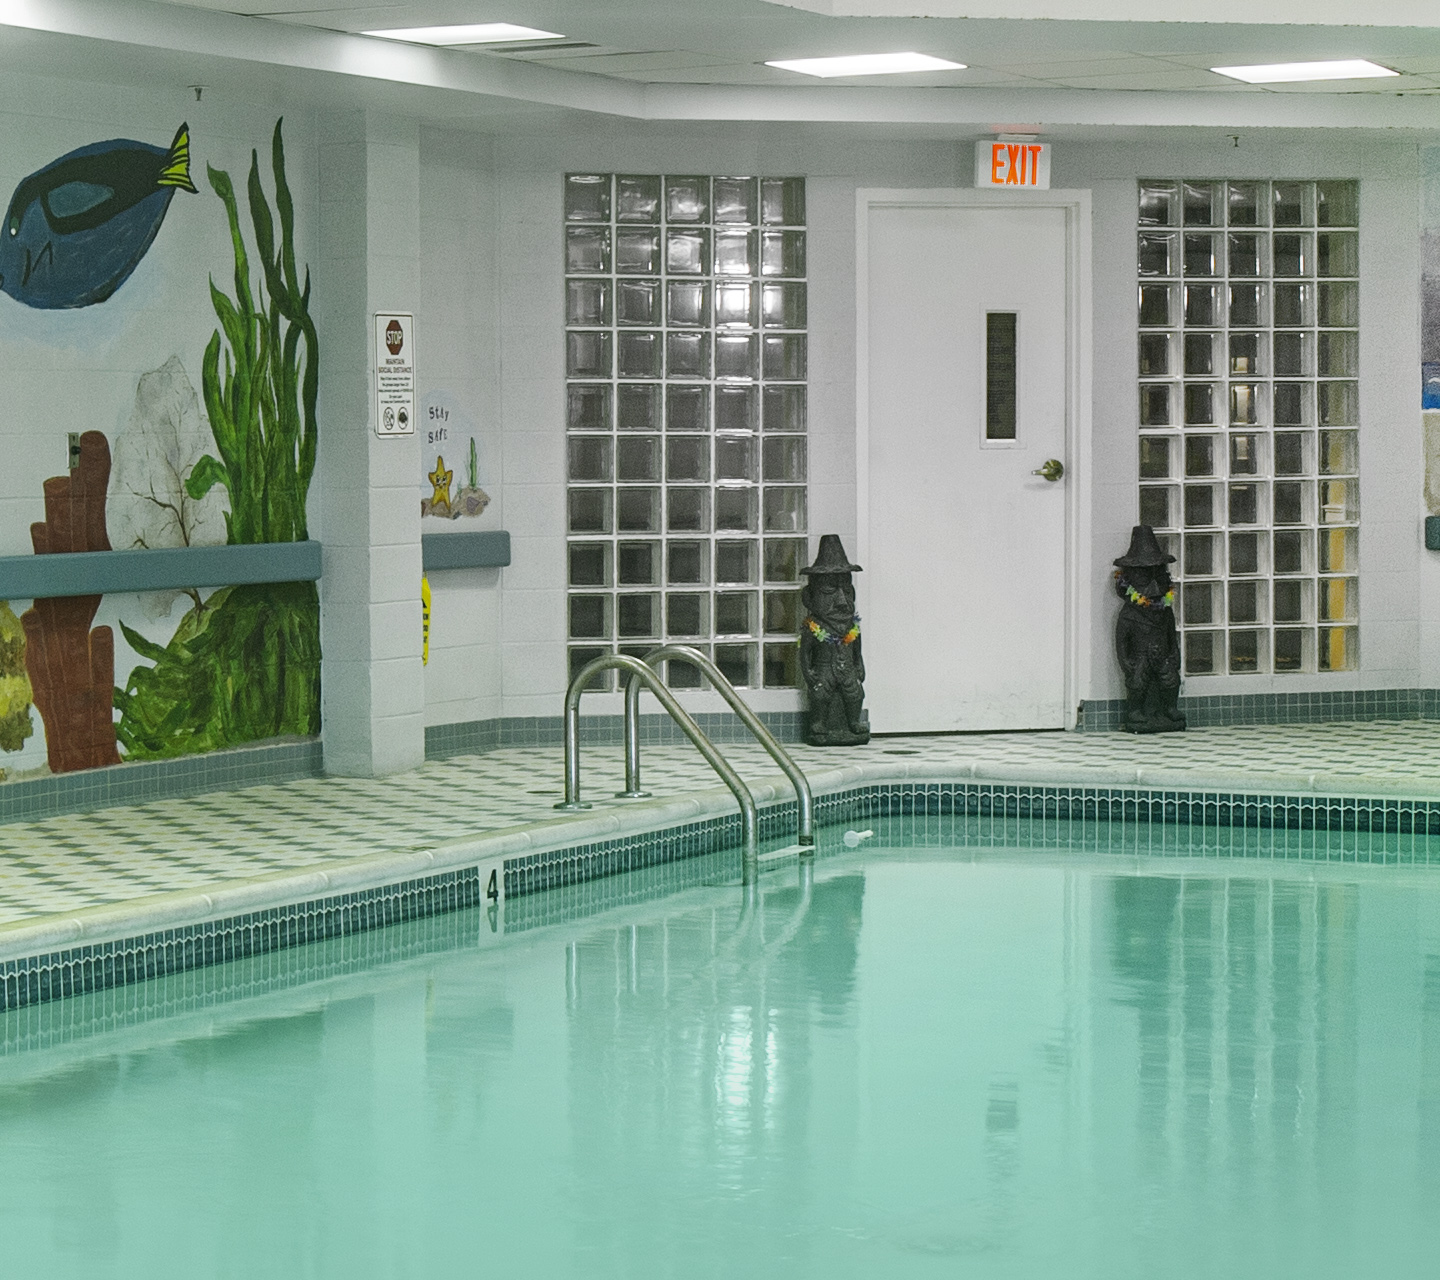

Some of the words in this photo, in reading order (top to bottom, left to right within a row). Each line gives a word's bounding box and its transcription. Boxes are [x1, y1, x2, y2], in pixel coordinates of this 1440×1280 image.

[991, 143, 1042, 186] EXIT
[386, 330, 403, 345] STOP
[486, 868, 499, 902] 4
